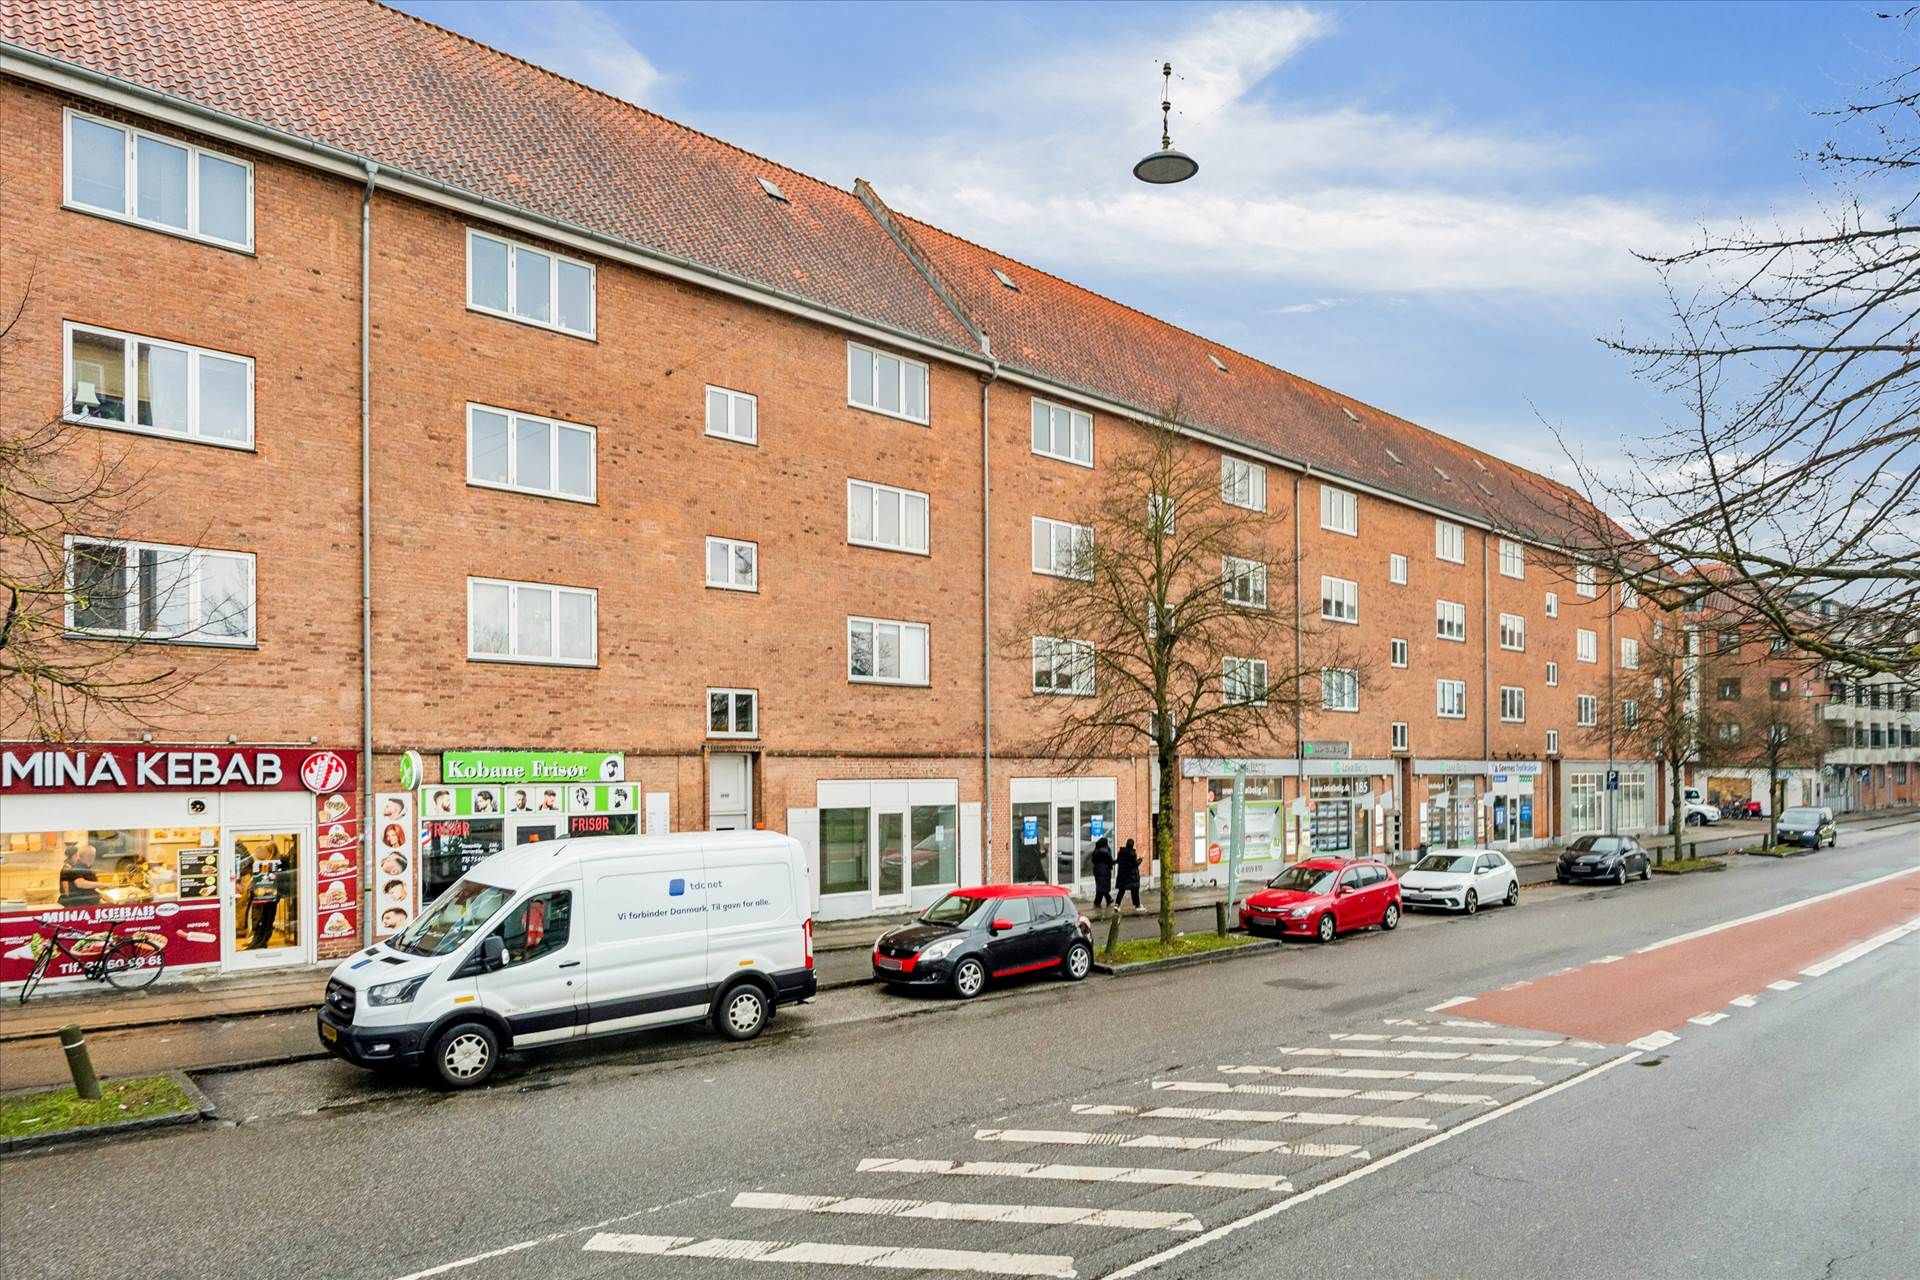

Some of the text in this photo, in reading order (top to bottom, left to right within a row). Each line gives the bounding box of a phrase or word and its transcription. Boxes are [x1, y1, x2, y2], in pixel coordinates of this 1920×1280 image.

[2, 752, 283, 787] MINA KEBAB
[448, 760, 588, 779] Kobane Frisør
[1609, 771, 1616, 782] P
[1355, 781, 1368, 793] 185
[572, 816, 609, 832] FRISØR
[617, 912, 627, 921] Vi
[629, 909, 668, 920] forbinder
[712, 903, 721, 911] Til
[743, 900, 753, 908] for
